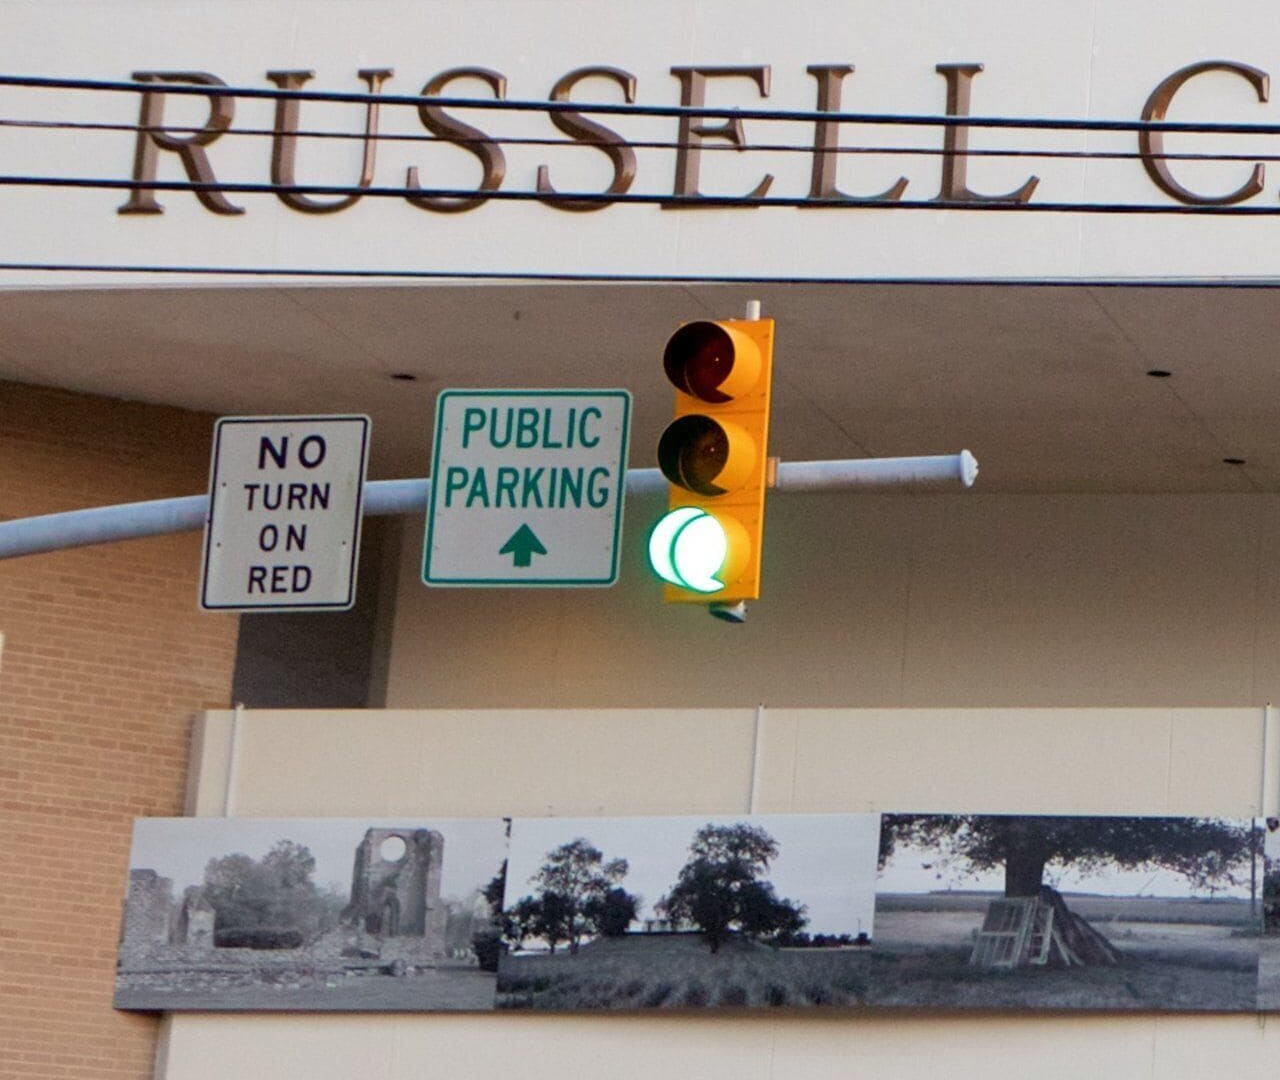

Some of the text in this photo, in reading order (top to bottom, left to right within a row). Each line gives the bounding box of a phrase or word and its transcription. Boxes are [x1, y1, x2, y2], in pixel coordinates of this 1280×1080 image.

[117, 62, 1039, 217] RUSSELL
[461, 406, 602, 449] PUBLIC
[257, 434, 327, 470] NO
[243, 482, 331, 511] TURN
[444, 466, 610, 509] PARKING
[258, 524, 307, 552] ON
[247, 565, 312, 594] RED
